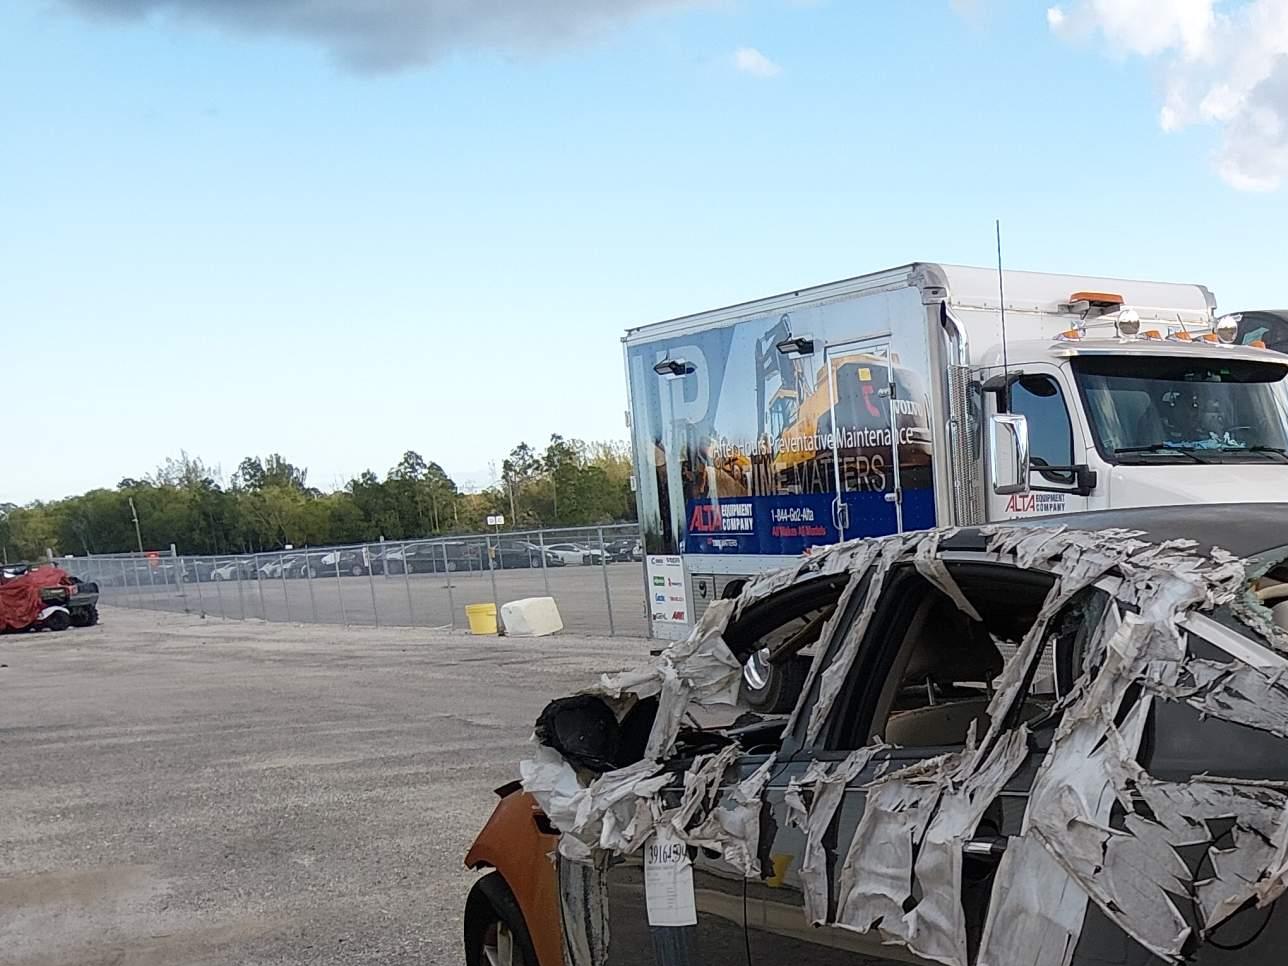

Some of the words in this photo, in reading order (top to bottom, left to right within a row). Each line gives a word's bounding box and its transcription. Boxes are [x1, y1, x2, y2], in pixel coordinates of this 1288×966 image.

[769, 431, 834, 455] Preventative
[1005, 495, 1035, 512] ALTA
[1035, 493, 1065, 502] EQUIPMENT
[721, 503, 752, 517] EQUIPMENT
[1036, 503, 1065, 512] COMPANY
[690, 504, 722, 532] ALTA
[722, 517, 754, 531] COMPANY
